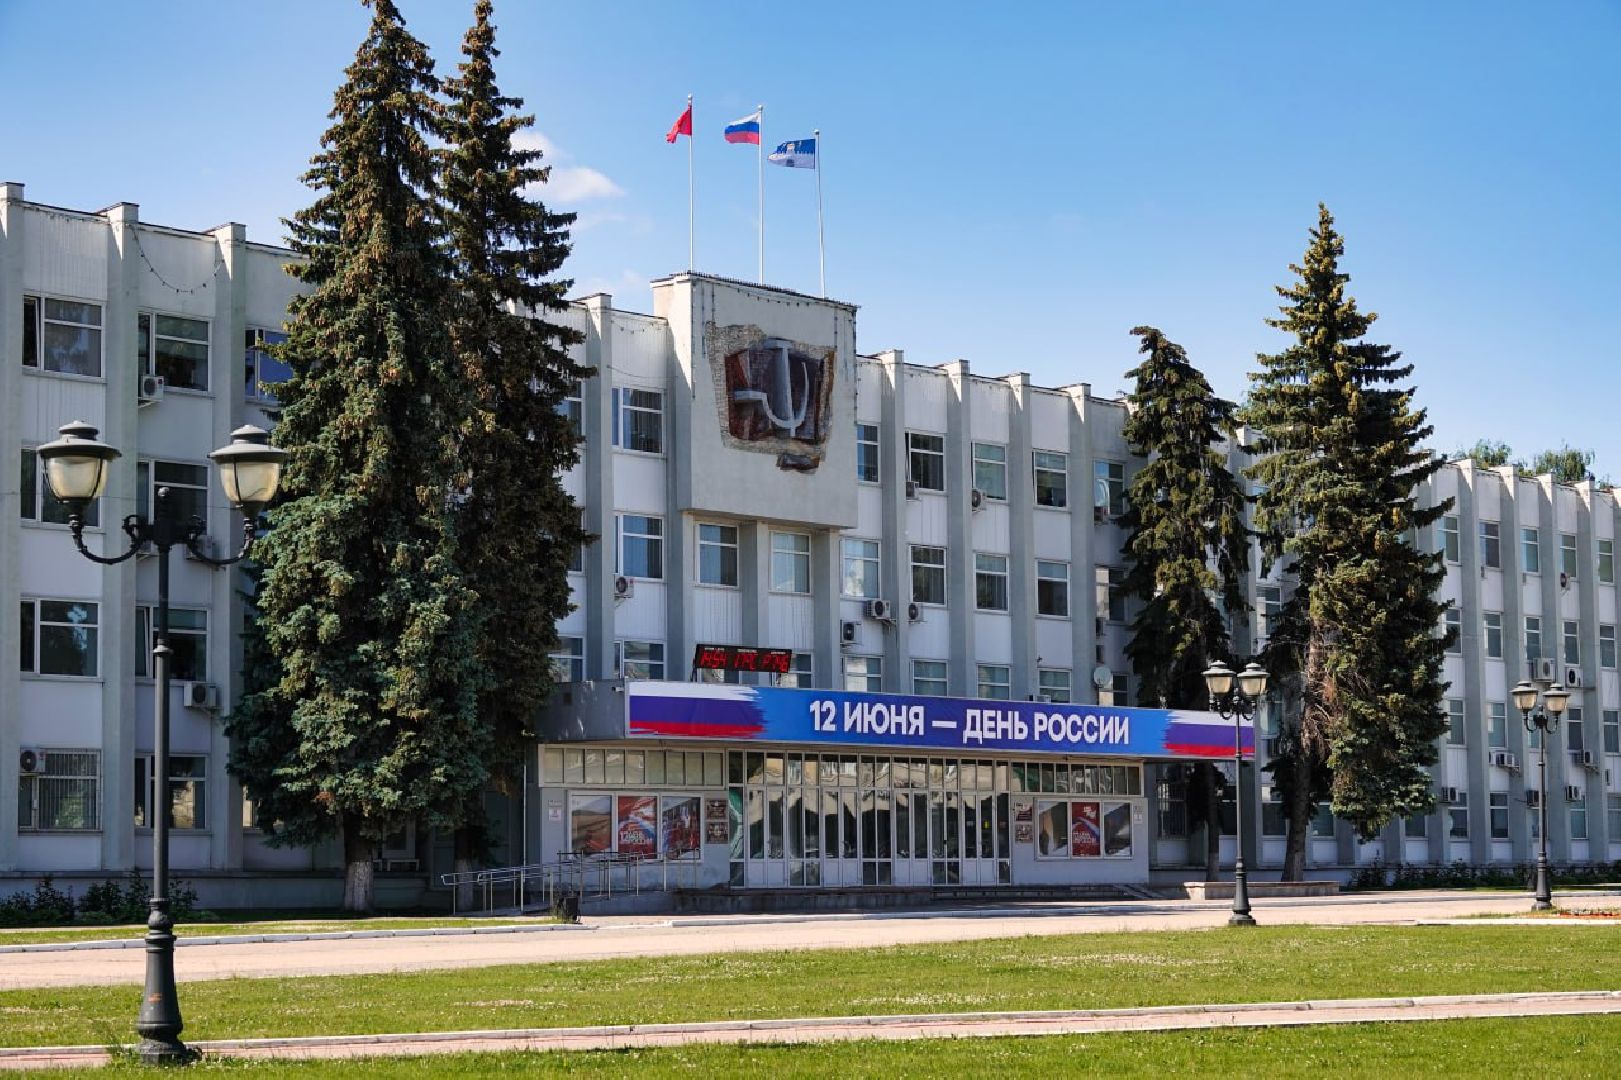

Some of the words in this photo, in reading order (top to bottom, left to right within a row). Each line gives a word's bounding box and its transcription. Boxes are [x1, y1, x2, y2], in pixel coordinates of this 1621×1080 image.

[810, 700, 836, 732] 12
[844, 701, 925, 736] ИЮНЯ
[932, 720, 957, 729] —
[963, 709, 1029, 744] ДЕНЬ
[1034, 712, 1129, 745] РОССИИ
